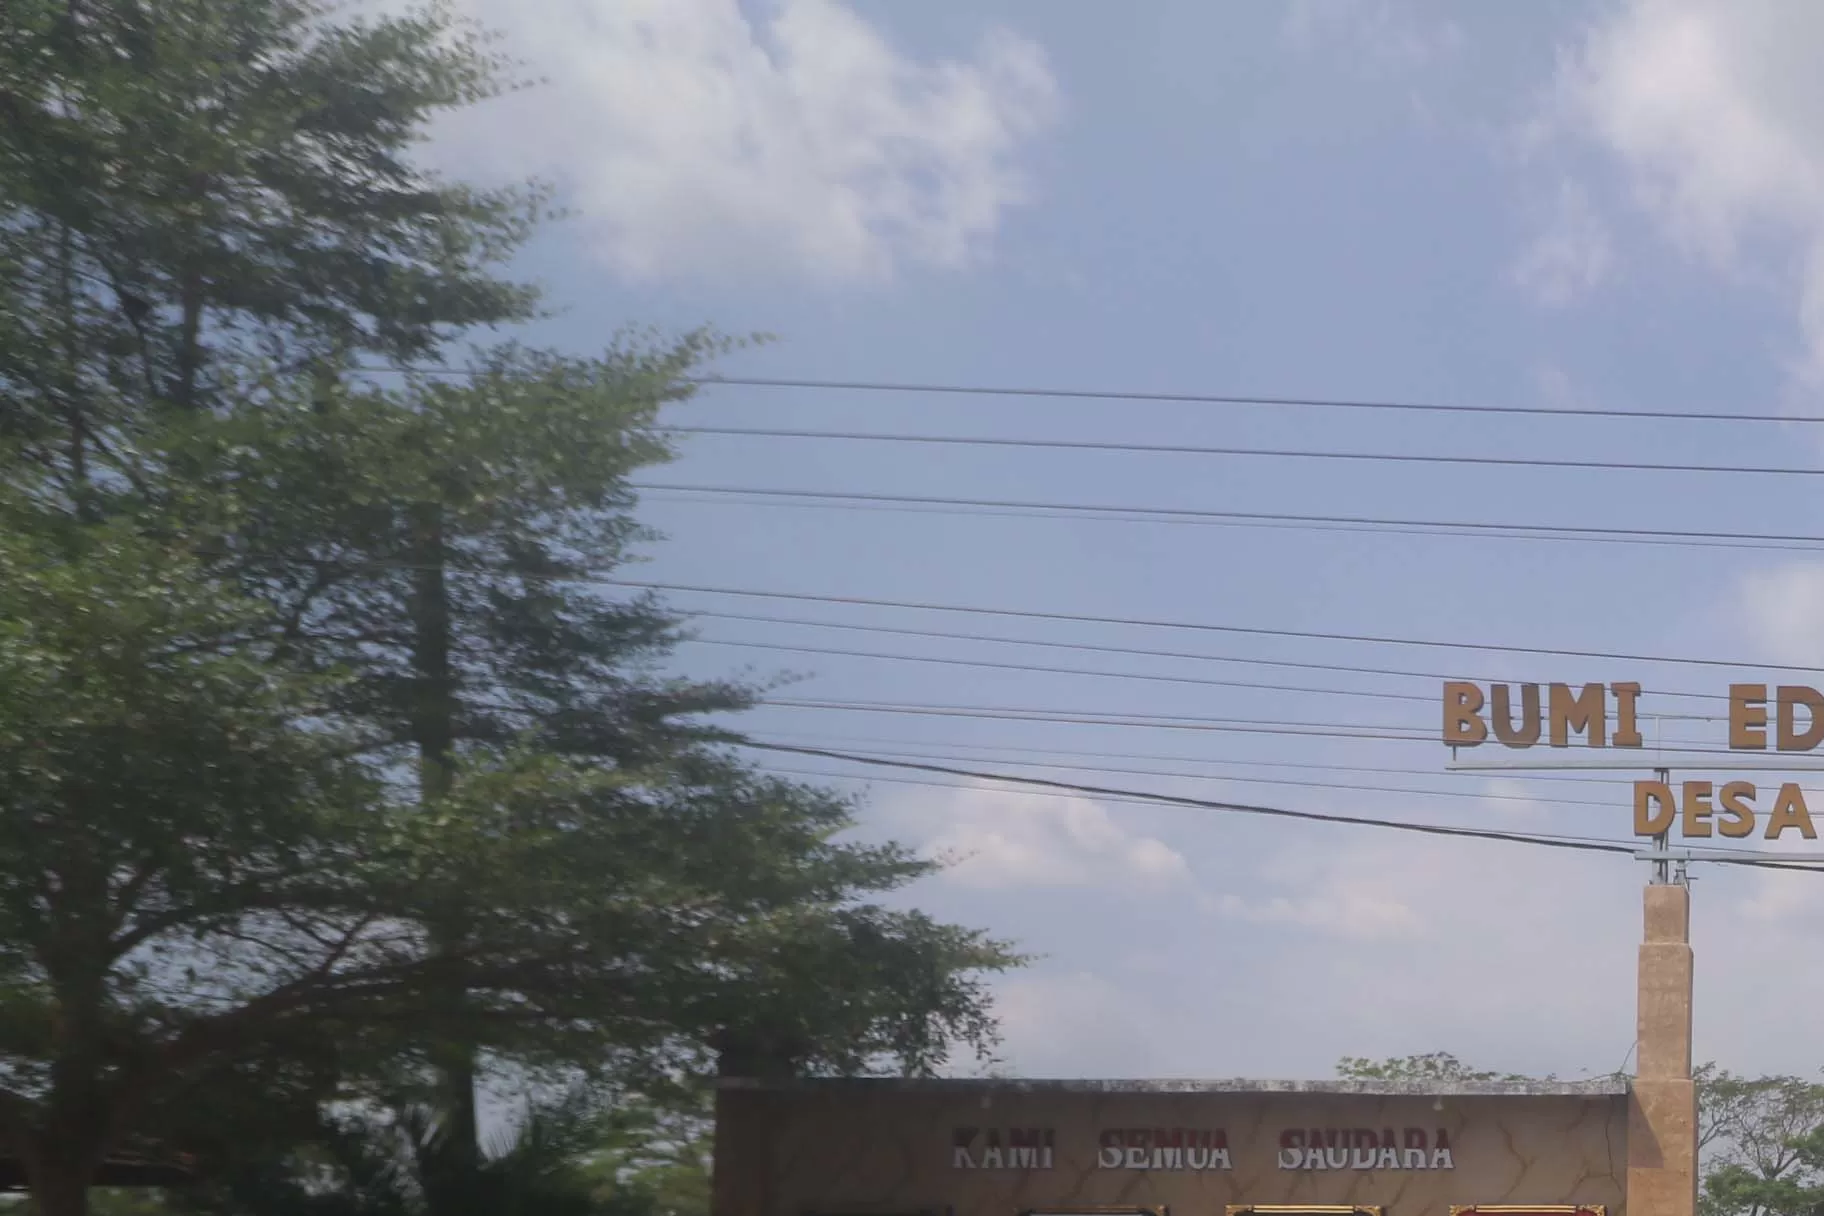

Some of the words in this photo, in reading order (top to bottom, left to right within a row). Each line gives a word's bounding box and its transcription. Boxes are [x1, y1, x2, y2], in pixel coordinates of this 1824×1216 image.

[1443, 681, 1643, 748] BUMI
[1633, 780, 1818, 840] DESA
[952, 1127, 1055, 1169] KAMI
[1098, 1128, 1233, 1170] SEMUA
[1278, 1128, 1456, 1170] SAUDARA
